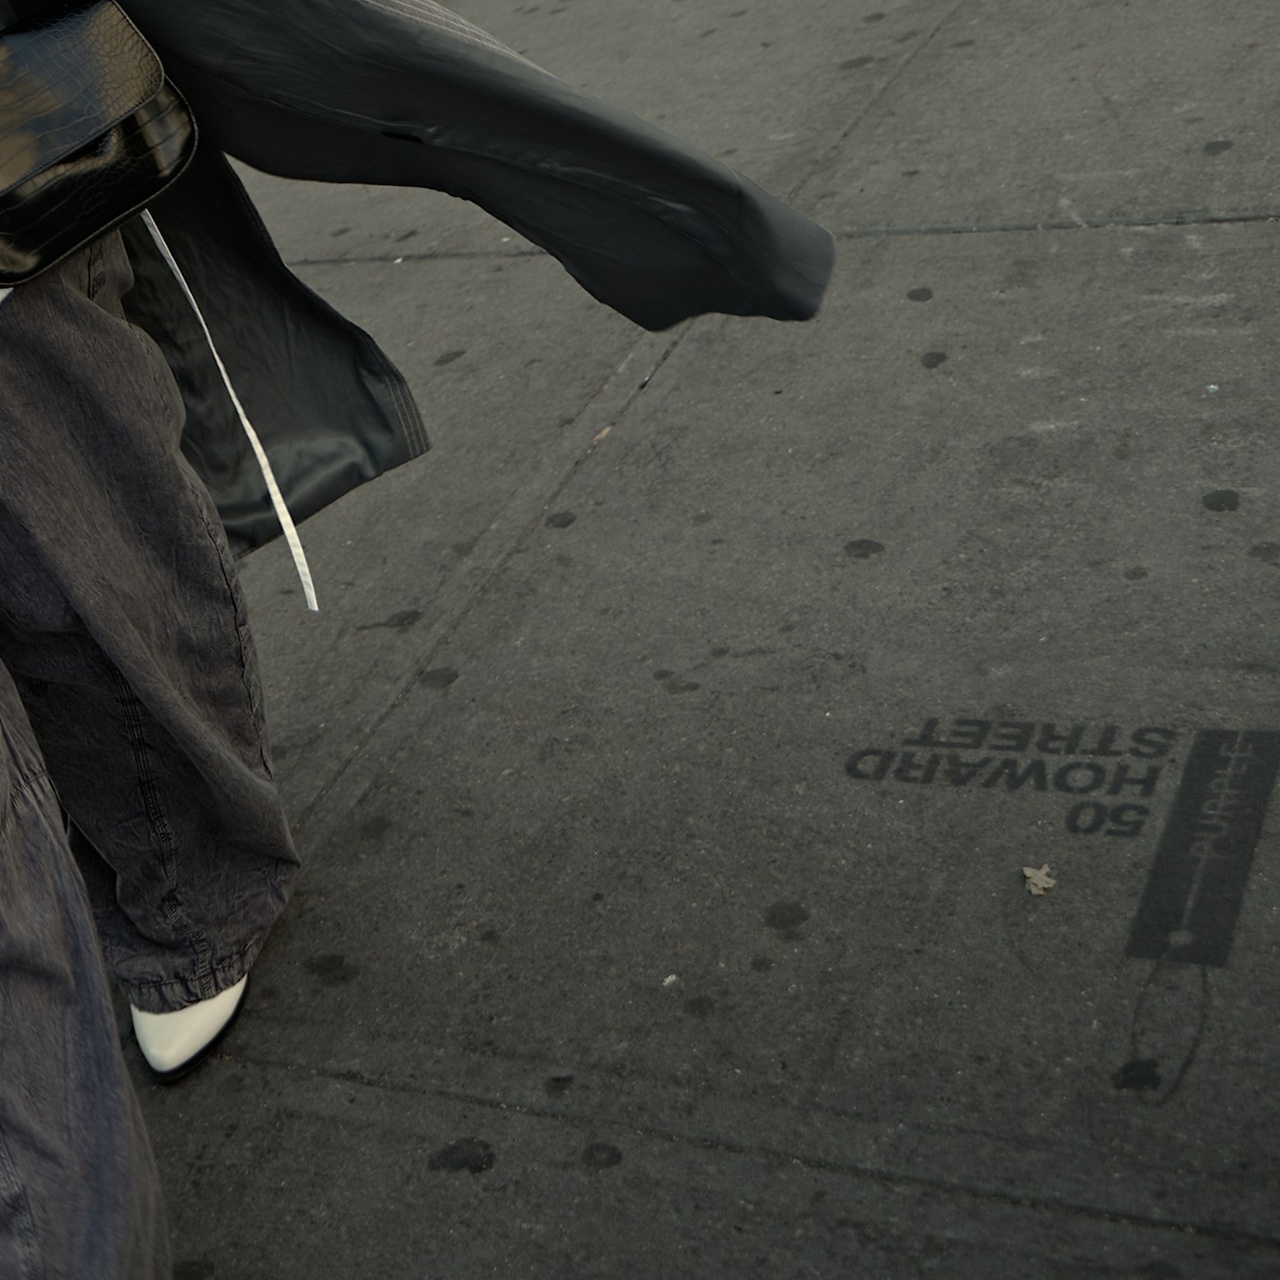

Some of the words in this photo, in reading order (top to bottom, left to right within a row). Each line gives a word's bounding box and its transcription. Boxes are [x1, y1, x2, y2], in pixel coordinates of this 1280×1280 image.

[905, 717, 1179, 761] STREET
[843, 747, 1163, 798] HOWARD
[1064, 800, 1151, 837] 50
